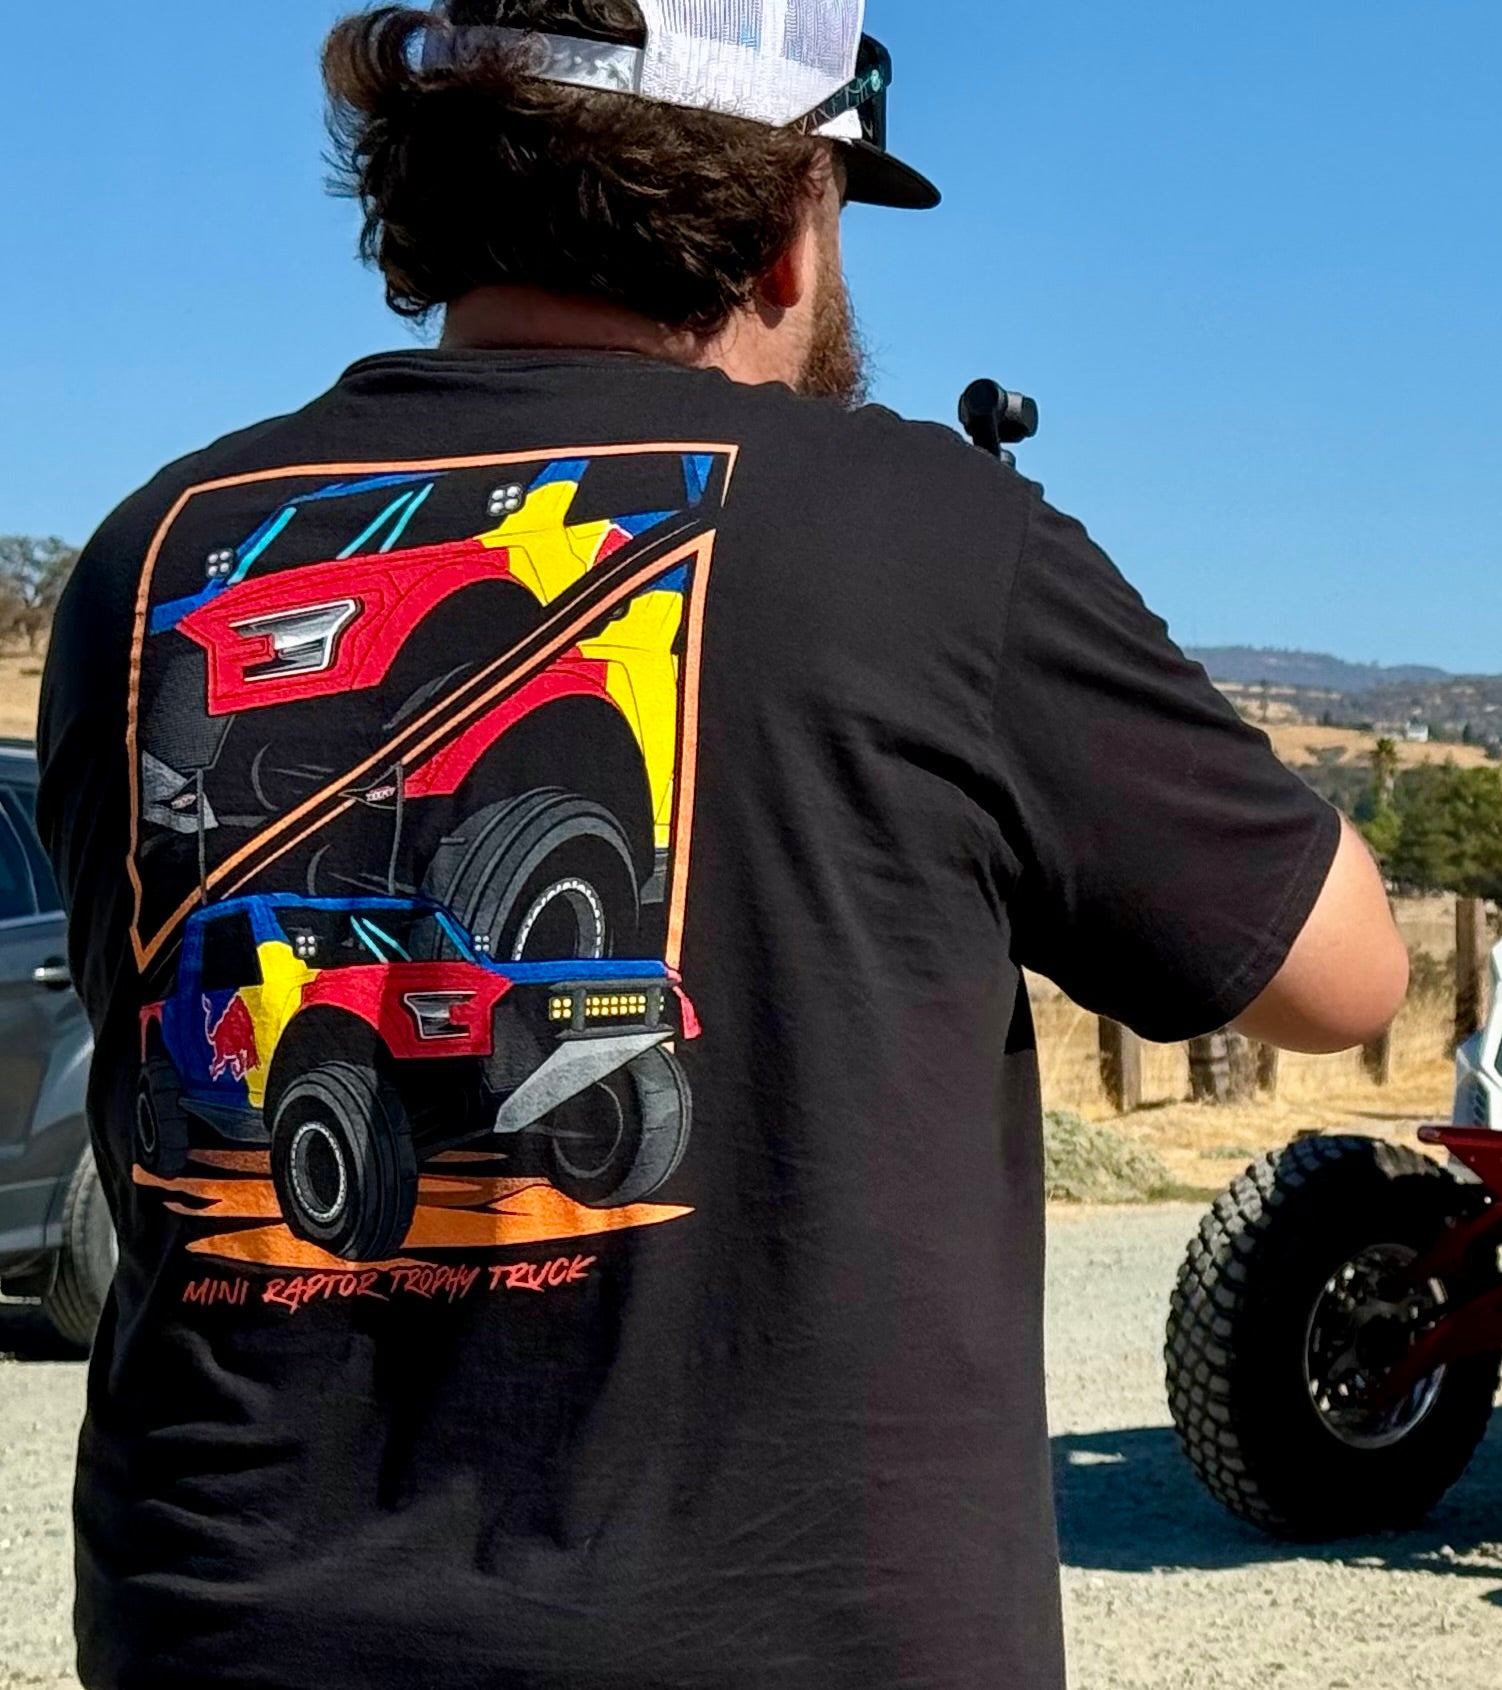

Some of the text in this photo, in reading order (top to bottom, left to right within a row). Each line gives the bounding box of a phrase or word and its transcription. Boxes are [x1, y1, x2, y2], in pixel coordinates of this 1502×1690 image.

[183, 1254, 597, 1314] MINI RAPTOR TROPHY TRUCK
